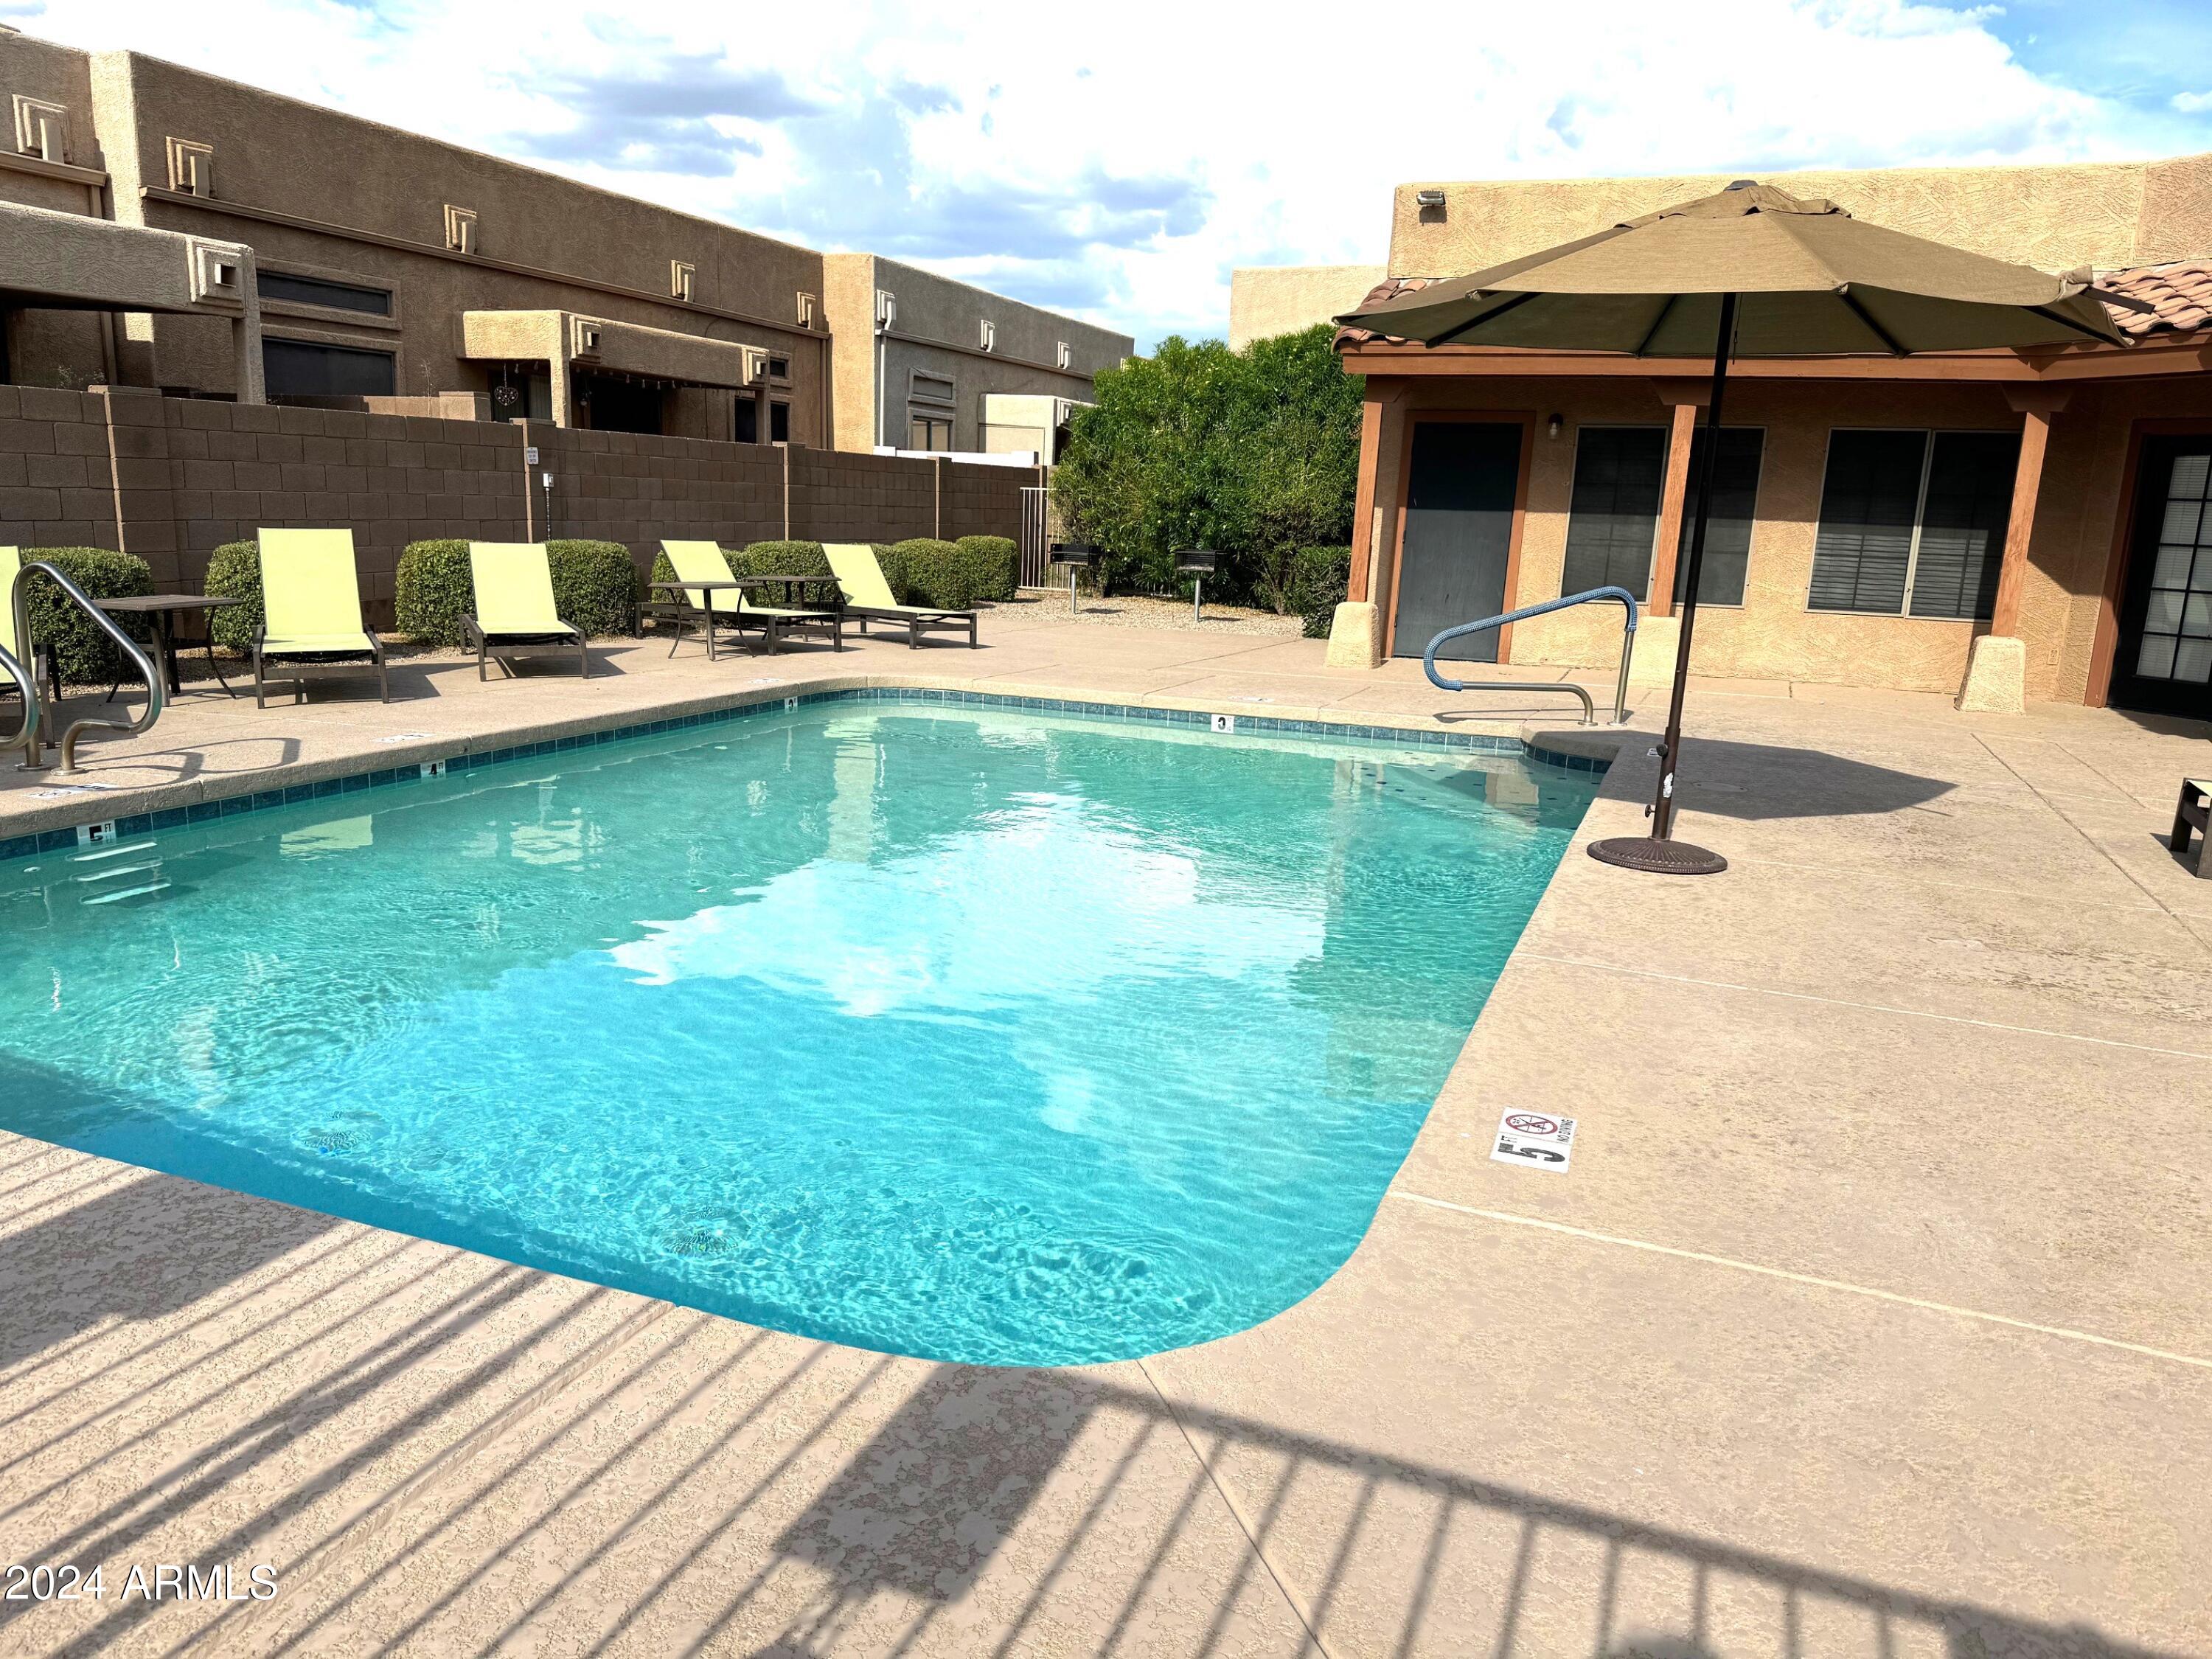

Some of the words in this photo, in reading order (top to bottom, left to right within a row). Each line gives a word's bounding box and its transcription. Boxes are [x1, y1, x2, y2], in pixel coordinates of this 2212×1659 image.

[88, 825, 103, 842] 5
[105, 823, 111, 832] FT
[1498, 1142, 1565, 1163] 5
